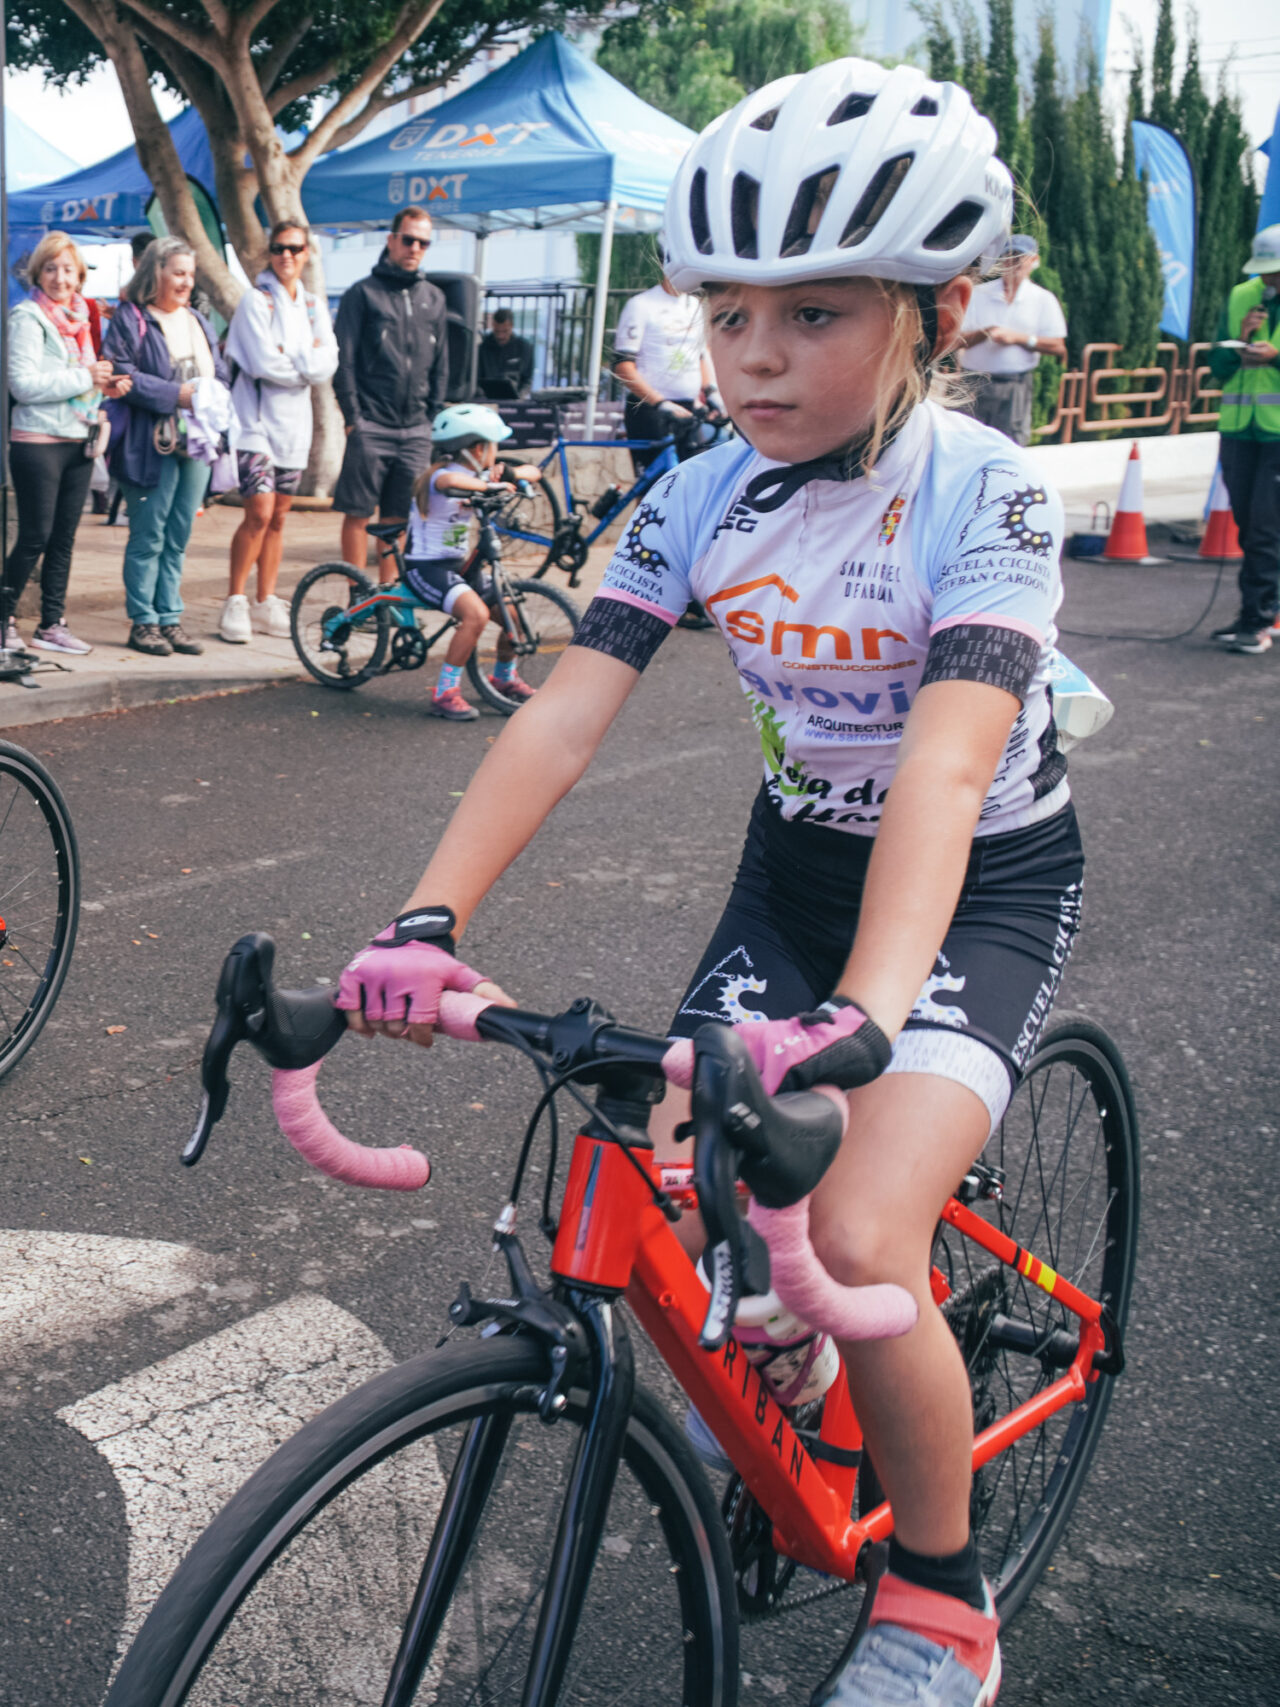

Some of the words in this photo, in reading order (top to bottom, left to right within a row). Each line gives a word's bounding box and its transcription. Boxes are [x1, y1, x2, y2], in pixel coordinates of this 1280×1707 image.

[424, 122, 551, 149] DXT
[410, 173, 469, 202] DXT
[61, 192, 119, 222] DXT
[614, 564, 664, 597] CICLISTA
[839, 560, 865, 578] SAN
[937, 572, 989, 594] STEBAN
[726, 610, 909, 661] smr
[782, 659, 918, 673] CONSTRUCCIONES
[739, 668, 911, 715] arovi
[804, 728, 902, 743] www.sarovi.co
[807, 714, 904, 733] ARQUITECTUR
[1011, 966, 1060, 1067] ESCUELA
[723, 1337, 804, 1486] RIBAN
